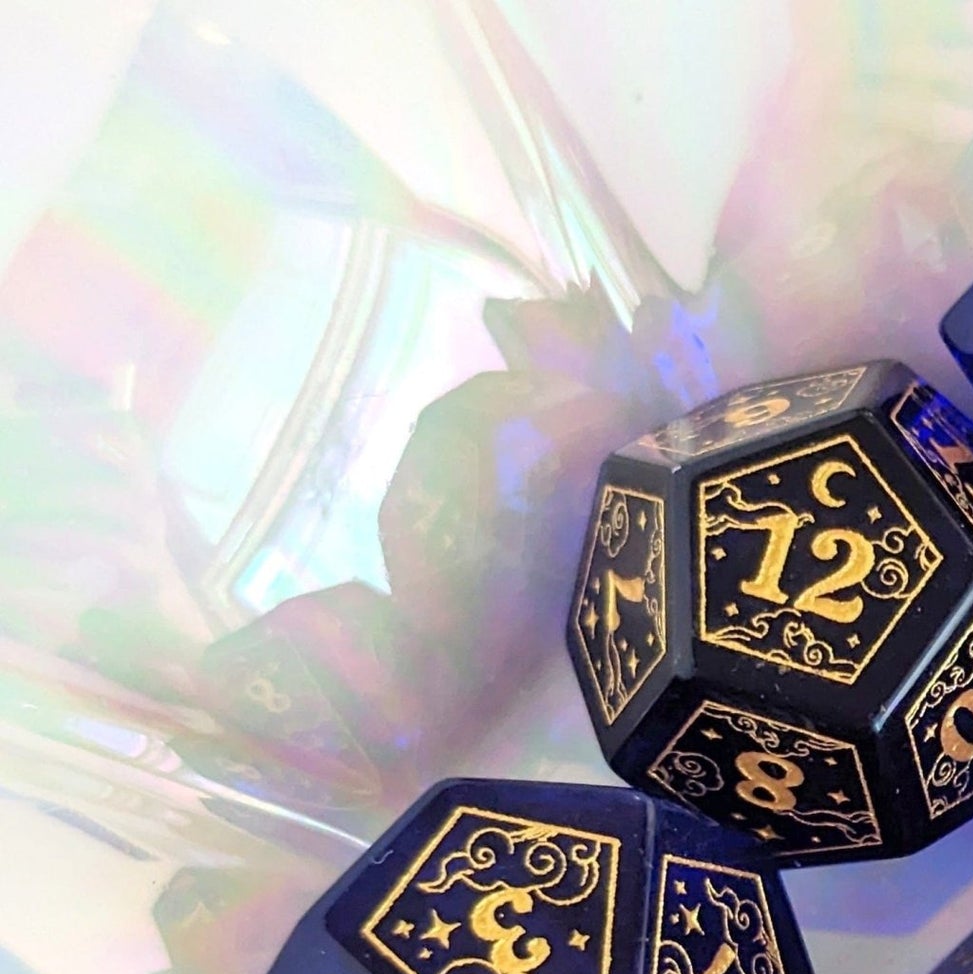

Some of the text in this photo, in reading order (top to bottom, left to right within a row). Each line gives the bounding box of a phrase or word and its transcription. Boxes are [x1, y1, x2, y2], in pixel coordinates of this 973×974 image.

[741, 514, 876, 624] 12
[605, 570, 645, 632] 7
[735, 751, 805, 811] 8
